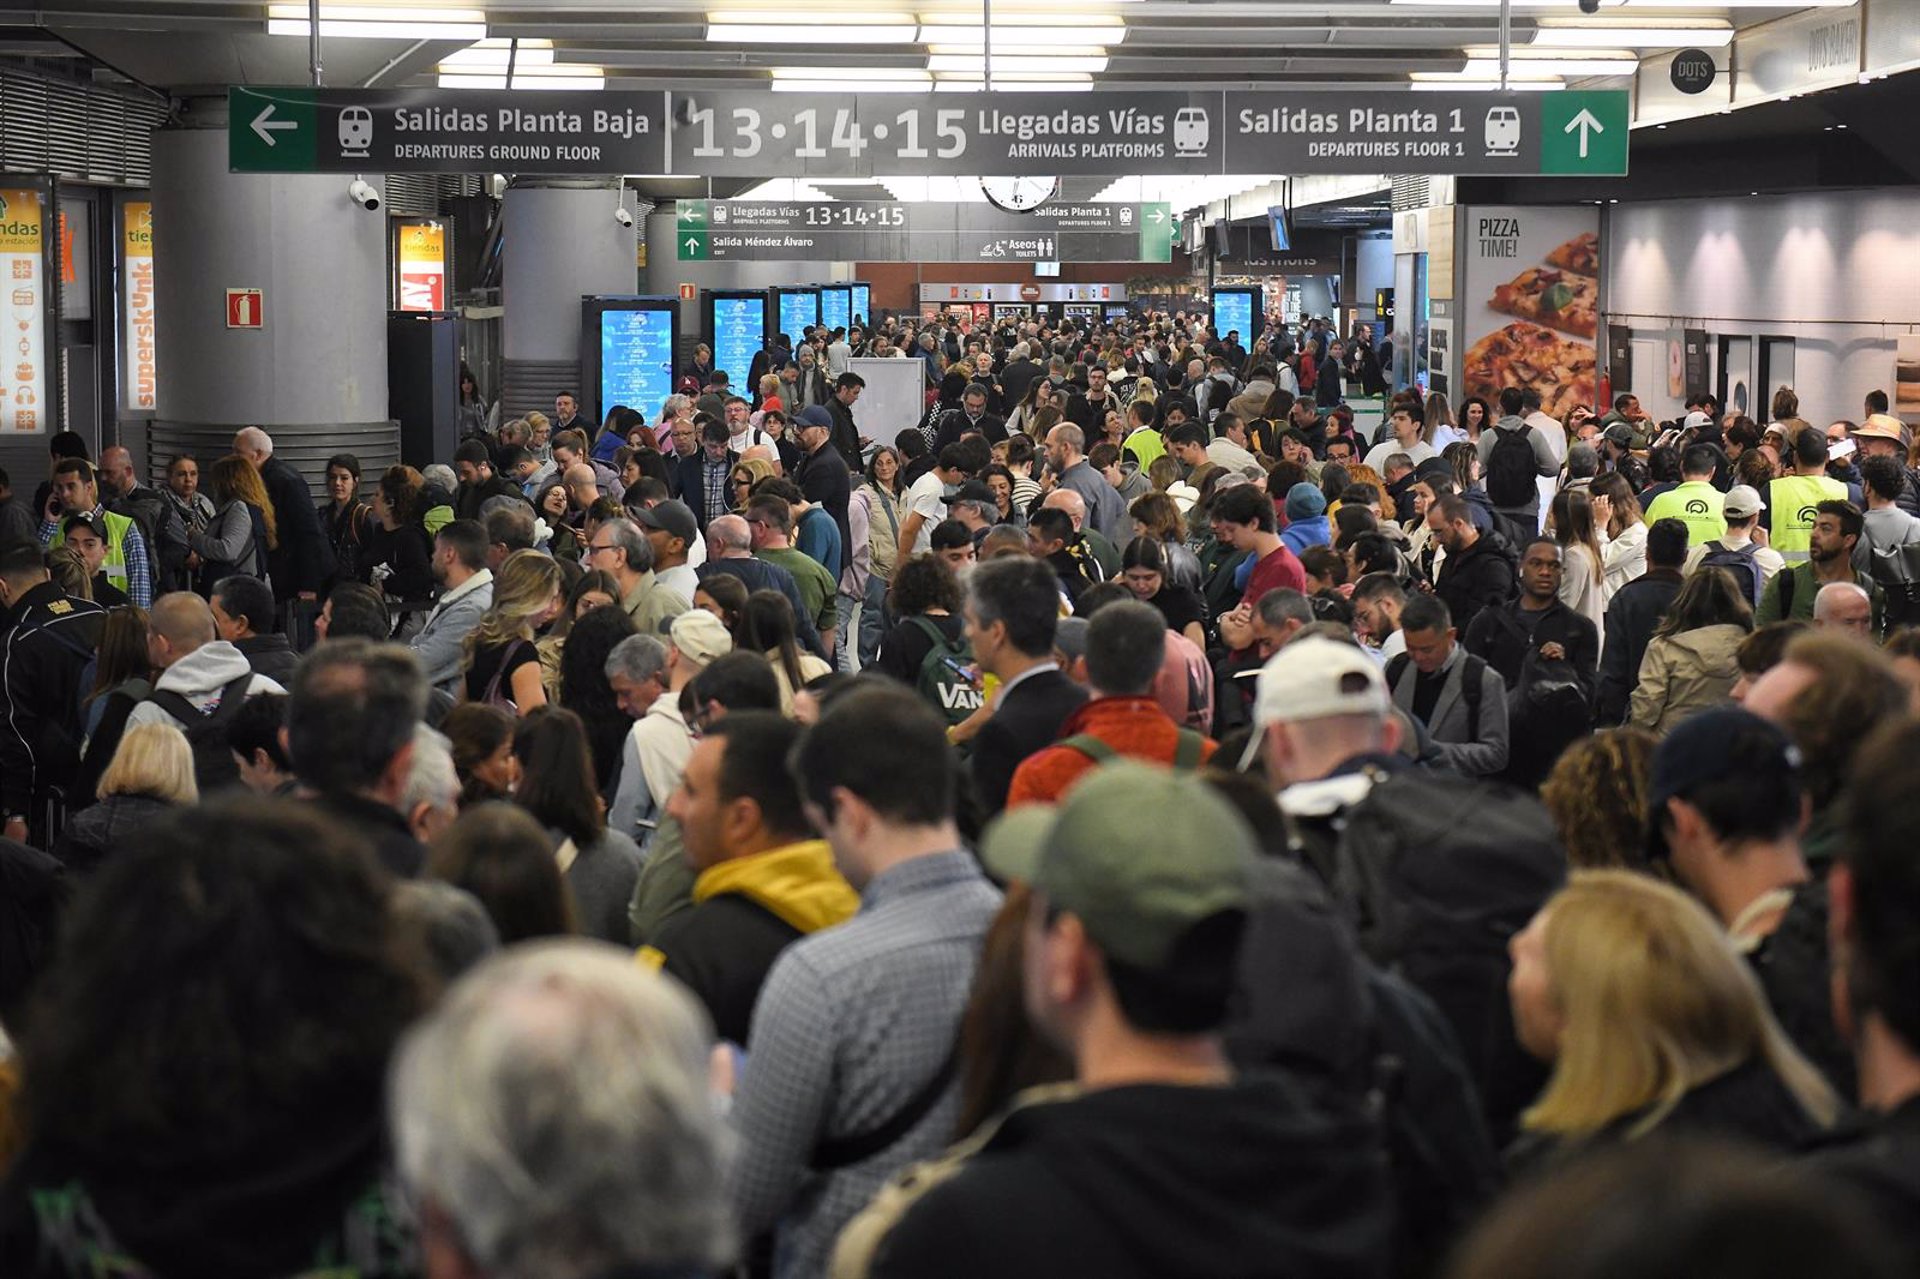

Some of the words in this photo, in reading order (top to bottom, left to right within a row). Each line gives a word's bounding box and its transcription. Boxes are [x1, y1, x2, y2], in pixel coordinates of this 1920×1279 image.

[394, 107, 488, 132] Salidas
[499, 109, 582, 133] Planta
[593, 109, 649, 138] Baja
[979, 109, 1100, 140] Llegadas
[1109, 107, 1165, 135] Vías
[1239, 107, 1339, 133] Salidas
[1349, 108, 1438, 133] Planta
[1449, 108, 1465, 133] 1
[395, 144, 485, 159] DEPARTURES
[489, 145, 550, 160] GROUND
[556, 146, 600, 160] FLOOR
[1008, 143, 1077, 158] ARRIVALS
[1081, 143, 1165, 158] PLATFORMS
[1308, 142, 1400, 157] DEPARTURES
[1404, 142, 1450, 157] FLOOR
[1455, 142, 1465, 157] 1
[732, 207, 777, 217] Llegadas
[779, 207, 800, 216] Vías
[1071, 207, 1102, 217] Planta
[1105, 207, 1111, 217] 1
[1480, 218, 1520, 237] PIZZA
[128, 230, 153, 243] tie
[713, 236, 742, 248] Salida
[744, 236, 782, 248] Méndez
[784, 236, 813, 248] Álvaro
[1009, 240, 1037, 249] Aseos
[1479, 239, 1517, 257] TIME!
[937, 682, 985, 709] VAN
